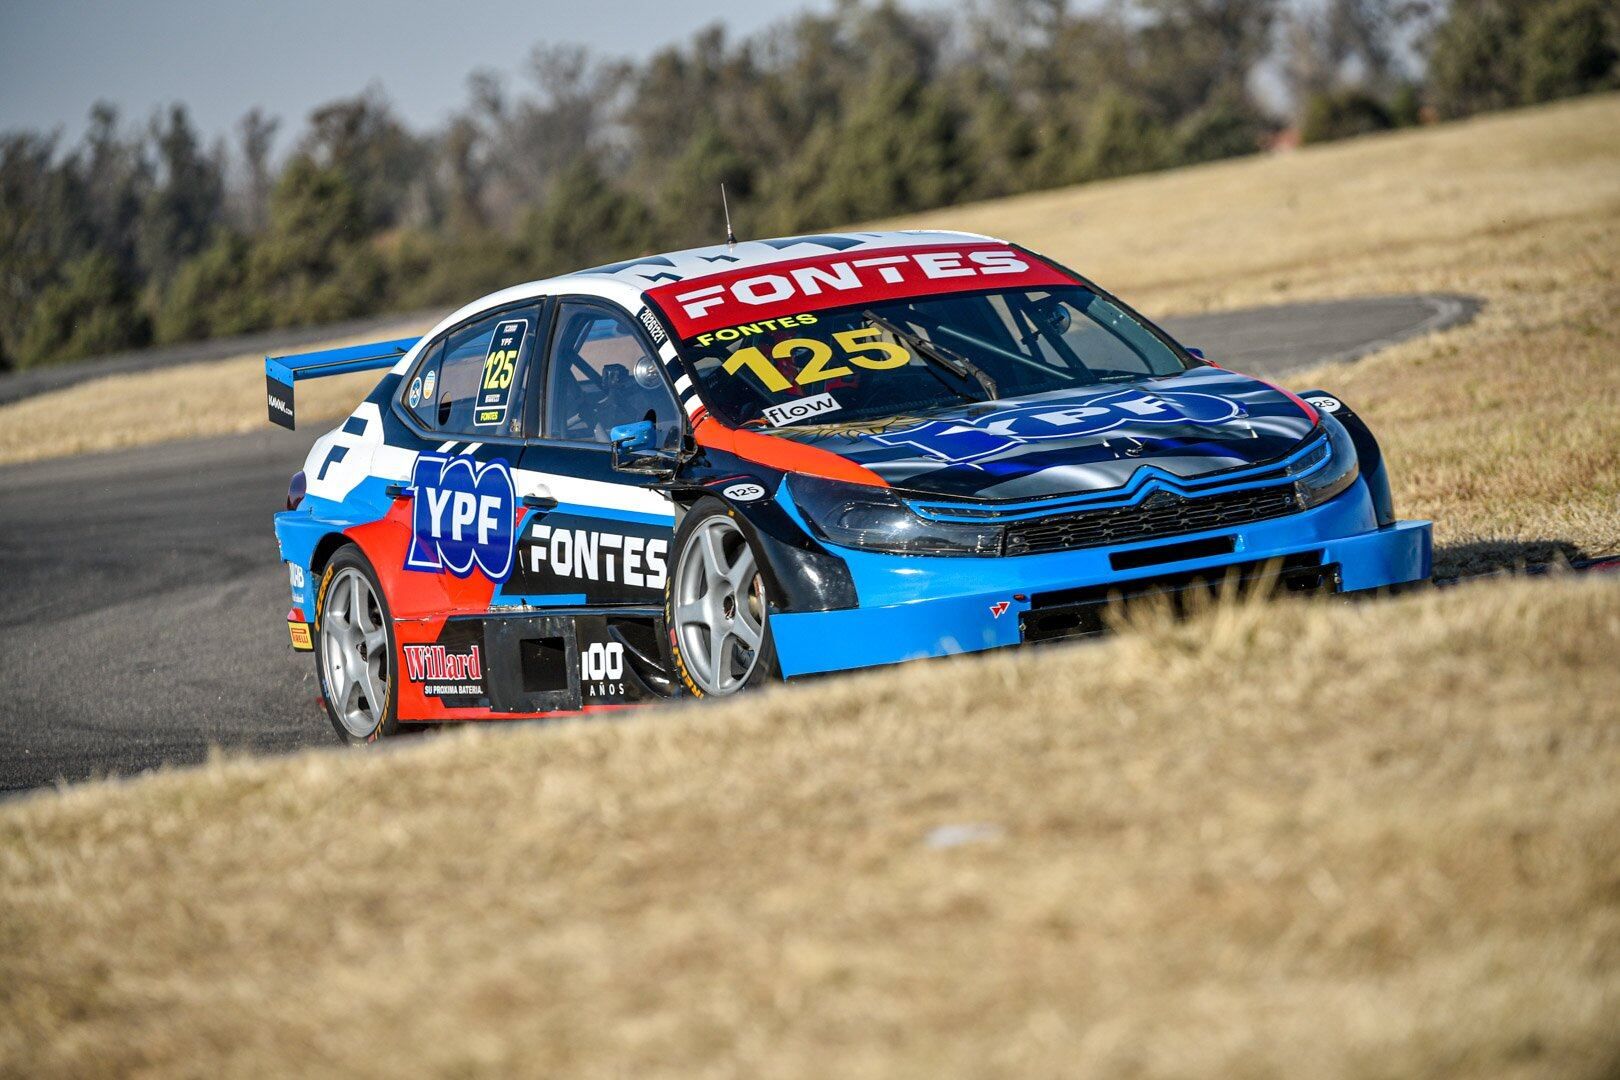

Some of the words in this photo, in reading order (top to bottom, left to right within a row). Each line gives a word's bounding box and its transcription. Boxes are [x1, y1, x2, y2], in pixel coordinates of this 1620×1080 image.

[675, 251, 1030, 319] FONTES
[501, 337, 513, 346] YPF
[640, 309, 665, 344] 20261221
[696, 313, 819, 348] FONTES
[483, 349, 518, 389] 125
[721, 327, 911, 393] 125
[768, 397, 833, 423] flow
[937, 394, 1188, 437] YPF
[1312, 399, 1335, 408] 25
[728, 486, 760, 498] 125
[425, 486, 502, 545] YPF
[531, 523, 668, 590] FONTES
[404, 645, 482, 681] Willard
[581, 642, 625, 681] 100
[424, 685, 433, 694] SU
